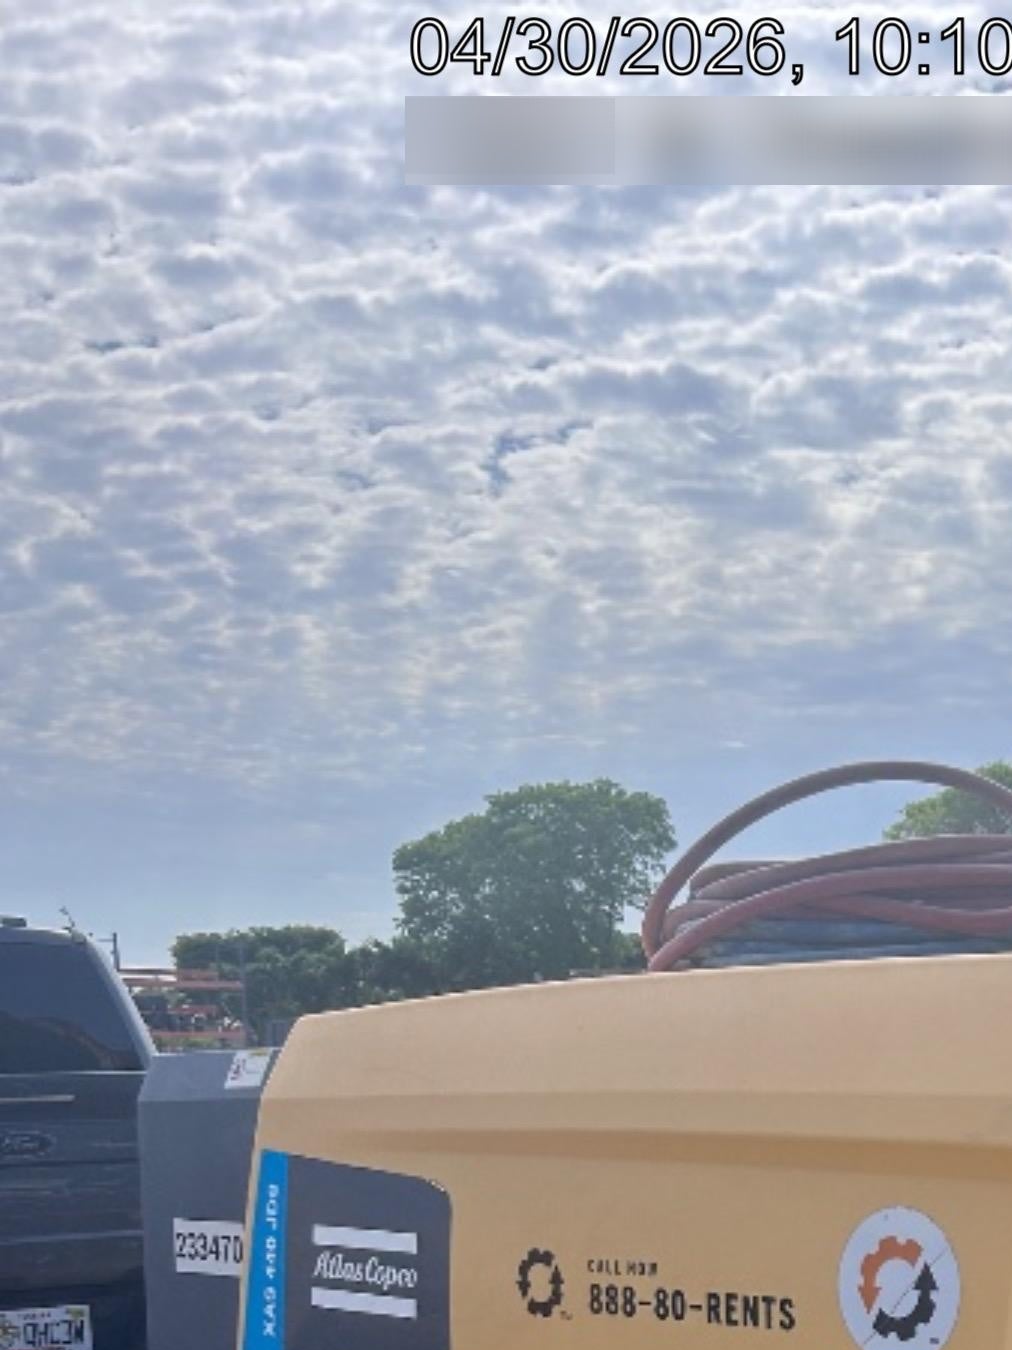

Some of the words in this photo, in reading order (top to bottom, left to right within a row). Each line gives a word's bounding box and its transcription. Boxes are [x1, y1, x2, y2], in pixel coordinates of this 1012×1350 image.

[175, 1232, 243, 1264] 233470
[312, 1251, 363, 1281] Atlas
[364, 1256, 418, 1291] Copco
[587, 1259, 622, 1276] CALL
[590, 1284, 796, 1331] 888-80-RENTS
